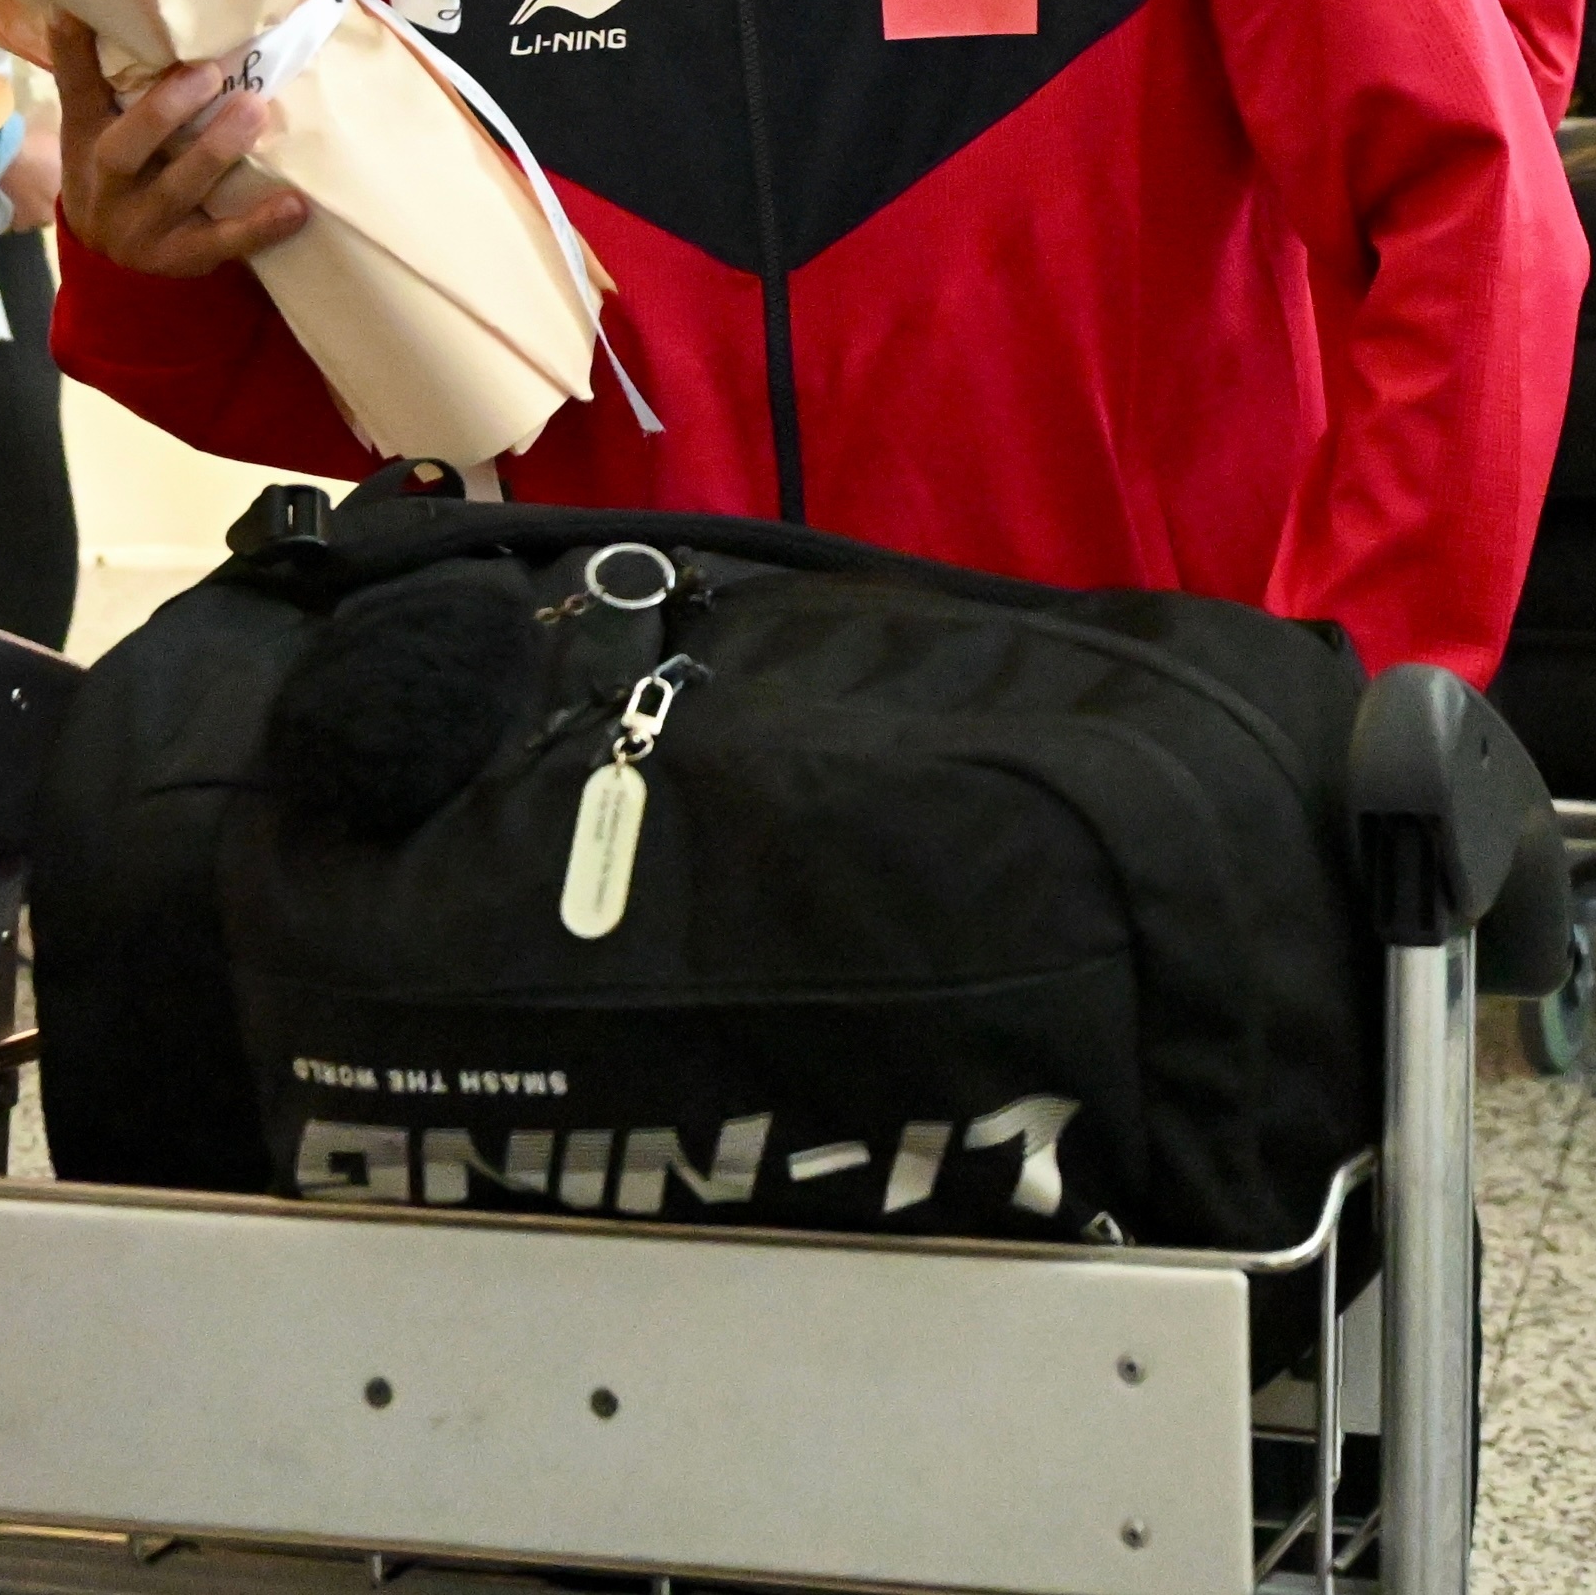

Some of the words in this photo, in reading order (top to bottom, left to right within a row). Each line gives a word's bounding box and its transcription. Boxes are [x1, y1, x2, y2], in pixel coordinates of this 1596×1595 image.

[510, 28, 627, 55] LI-NING
[293, 1057, 378, 1090] WORLD
[387, 1069, 448, 1094] THE
[458, 1070, 568, 1095] SMASH
[296, 1094, 1082, 1216] LI-NING
